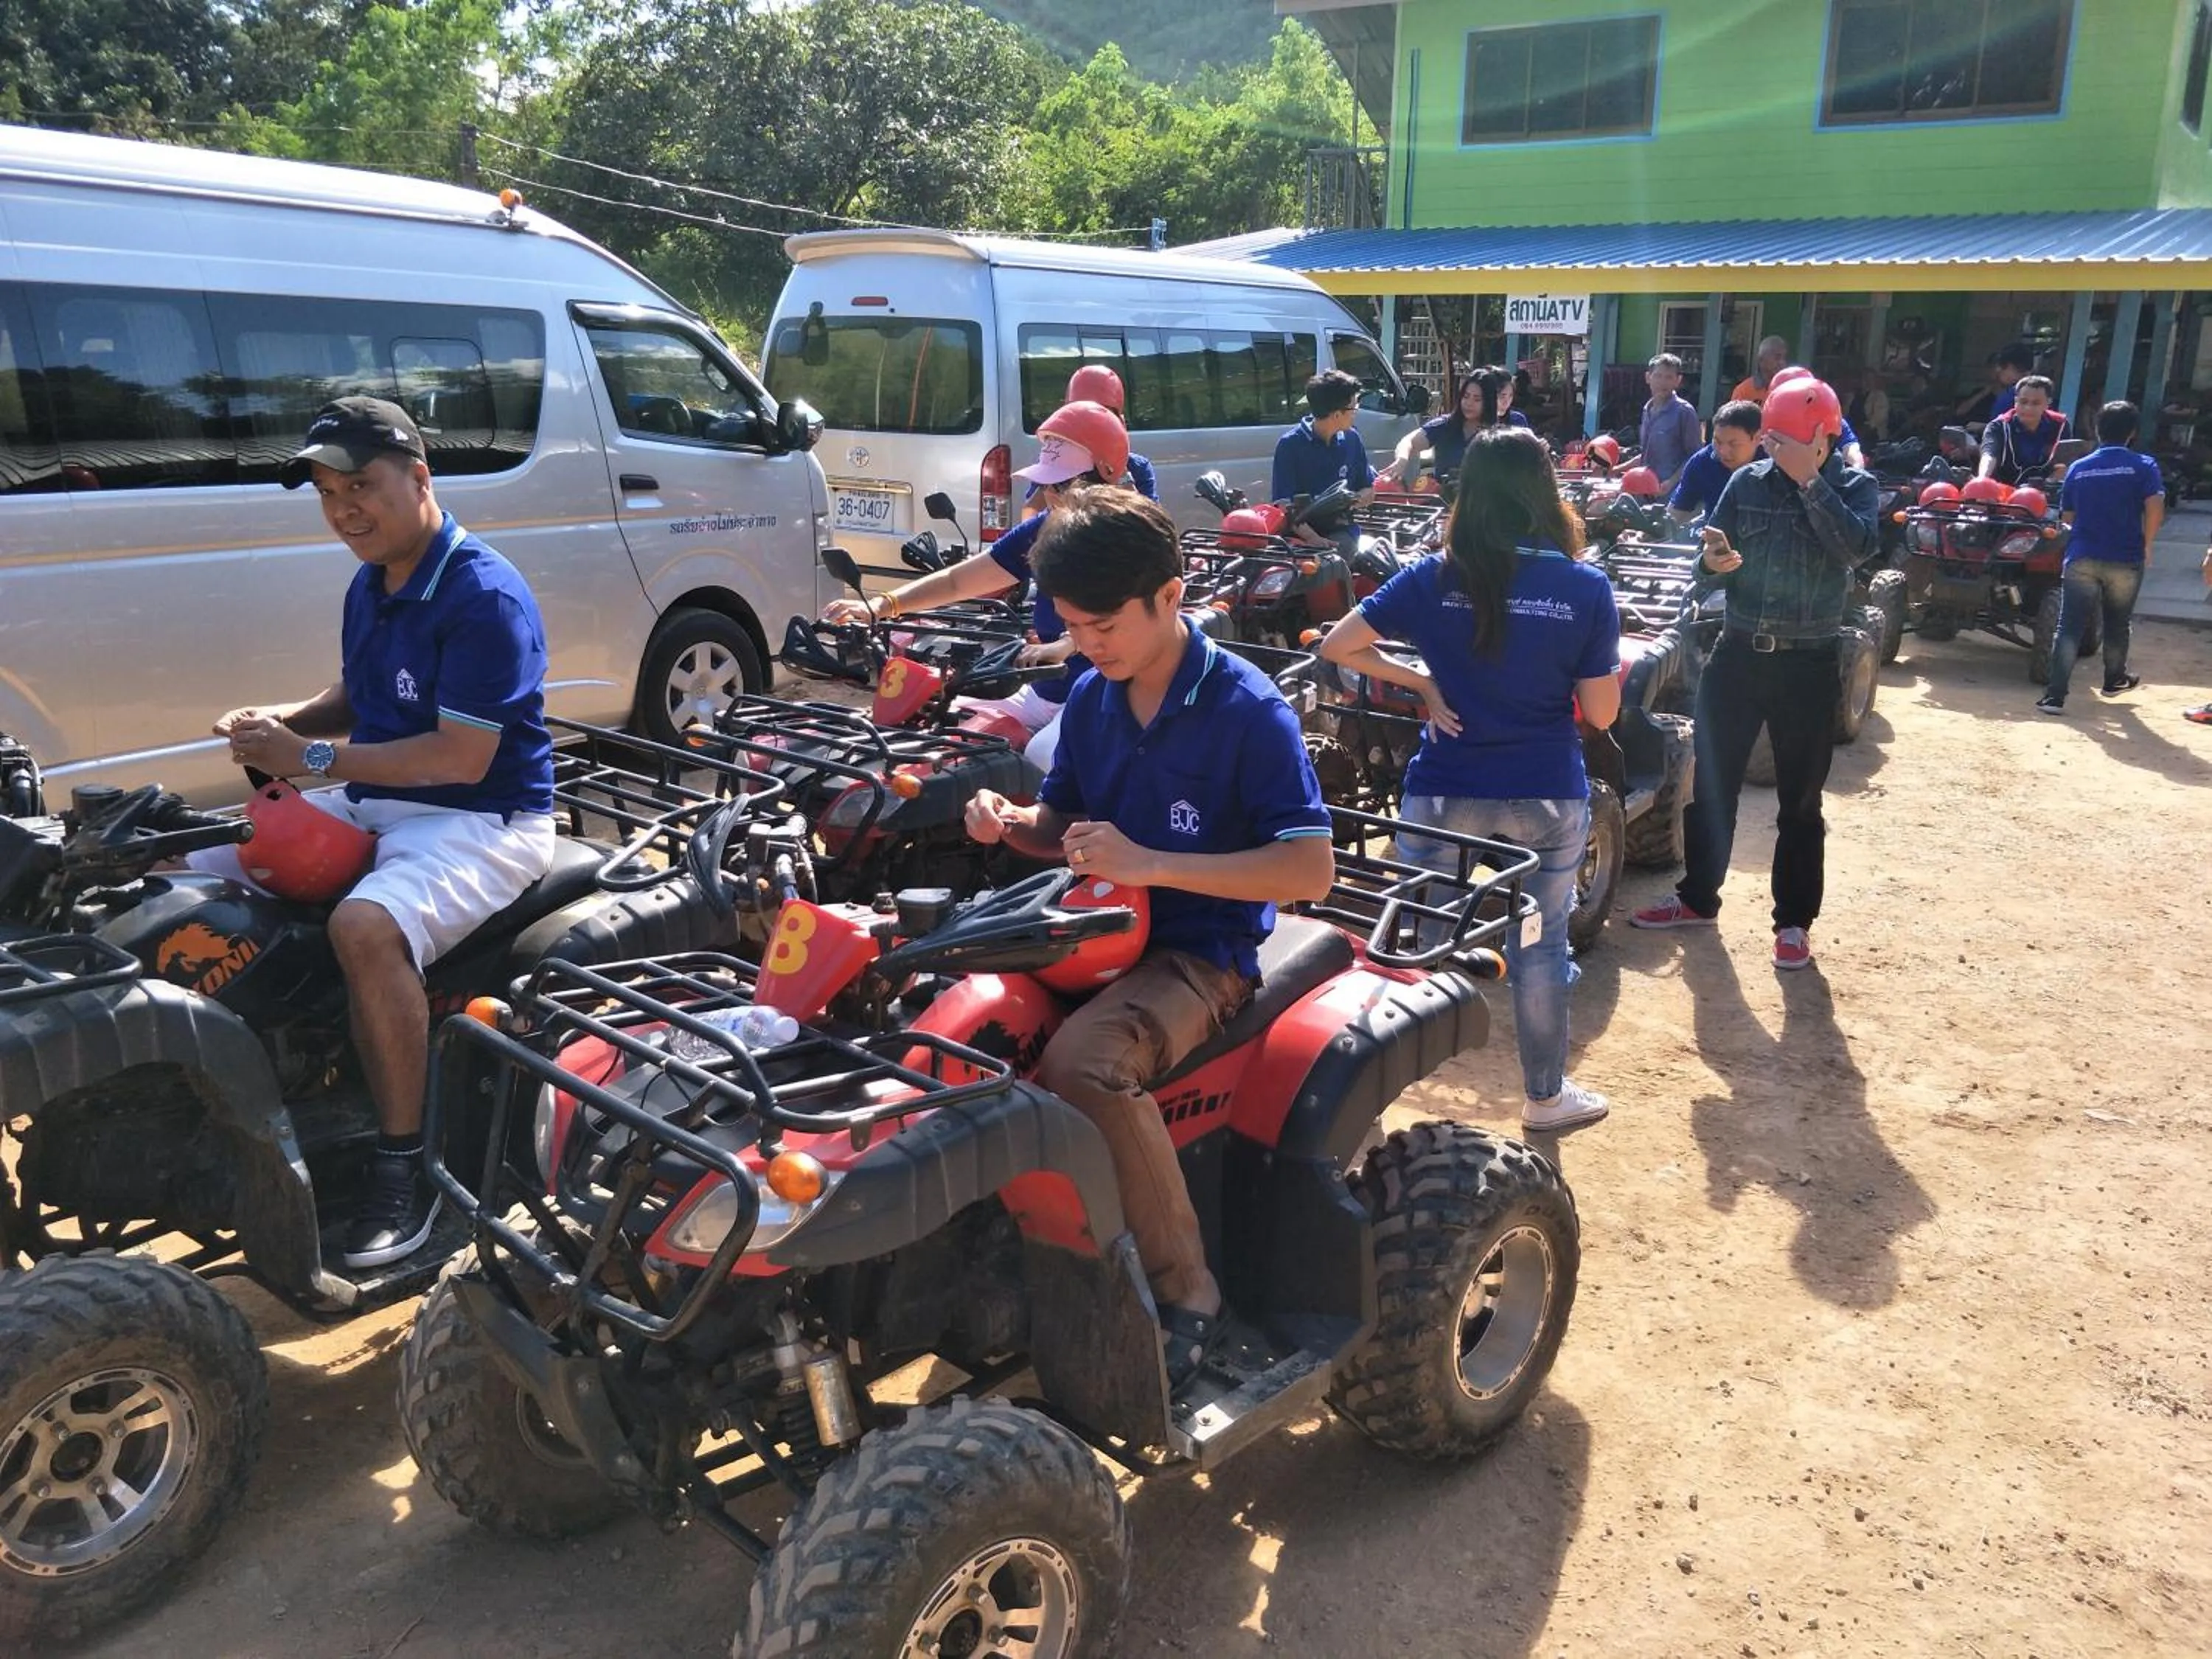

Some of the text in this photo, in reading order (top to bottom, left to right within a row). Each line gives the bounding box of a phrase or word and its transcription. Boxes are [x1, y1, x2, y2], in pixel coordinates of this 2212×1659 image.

[838, 497, 890, 520] 36-0407
[397, 678, 419, 699] BJC
[880, 660, 908, 698] 3
[1170, 808, 1200, 832] BJC
[768, 903, 816, 974] 8
